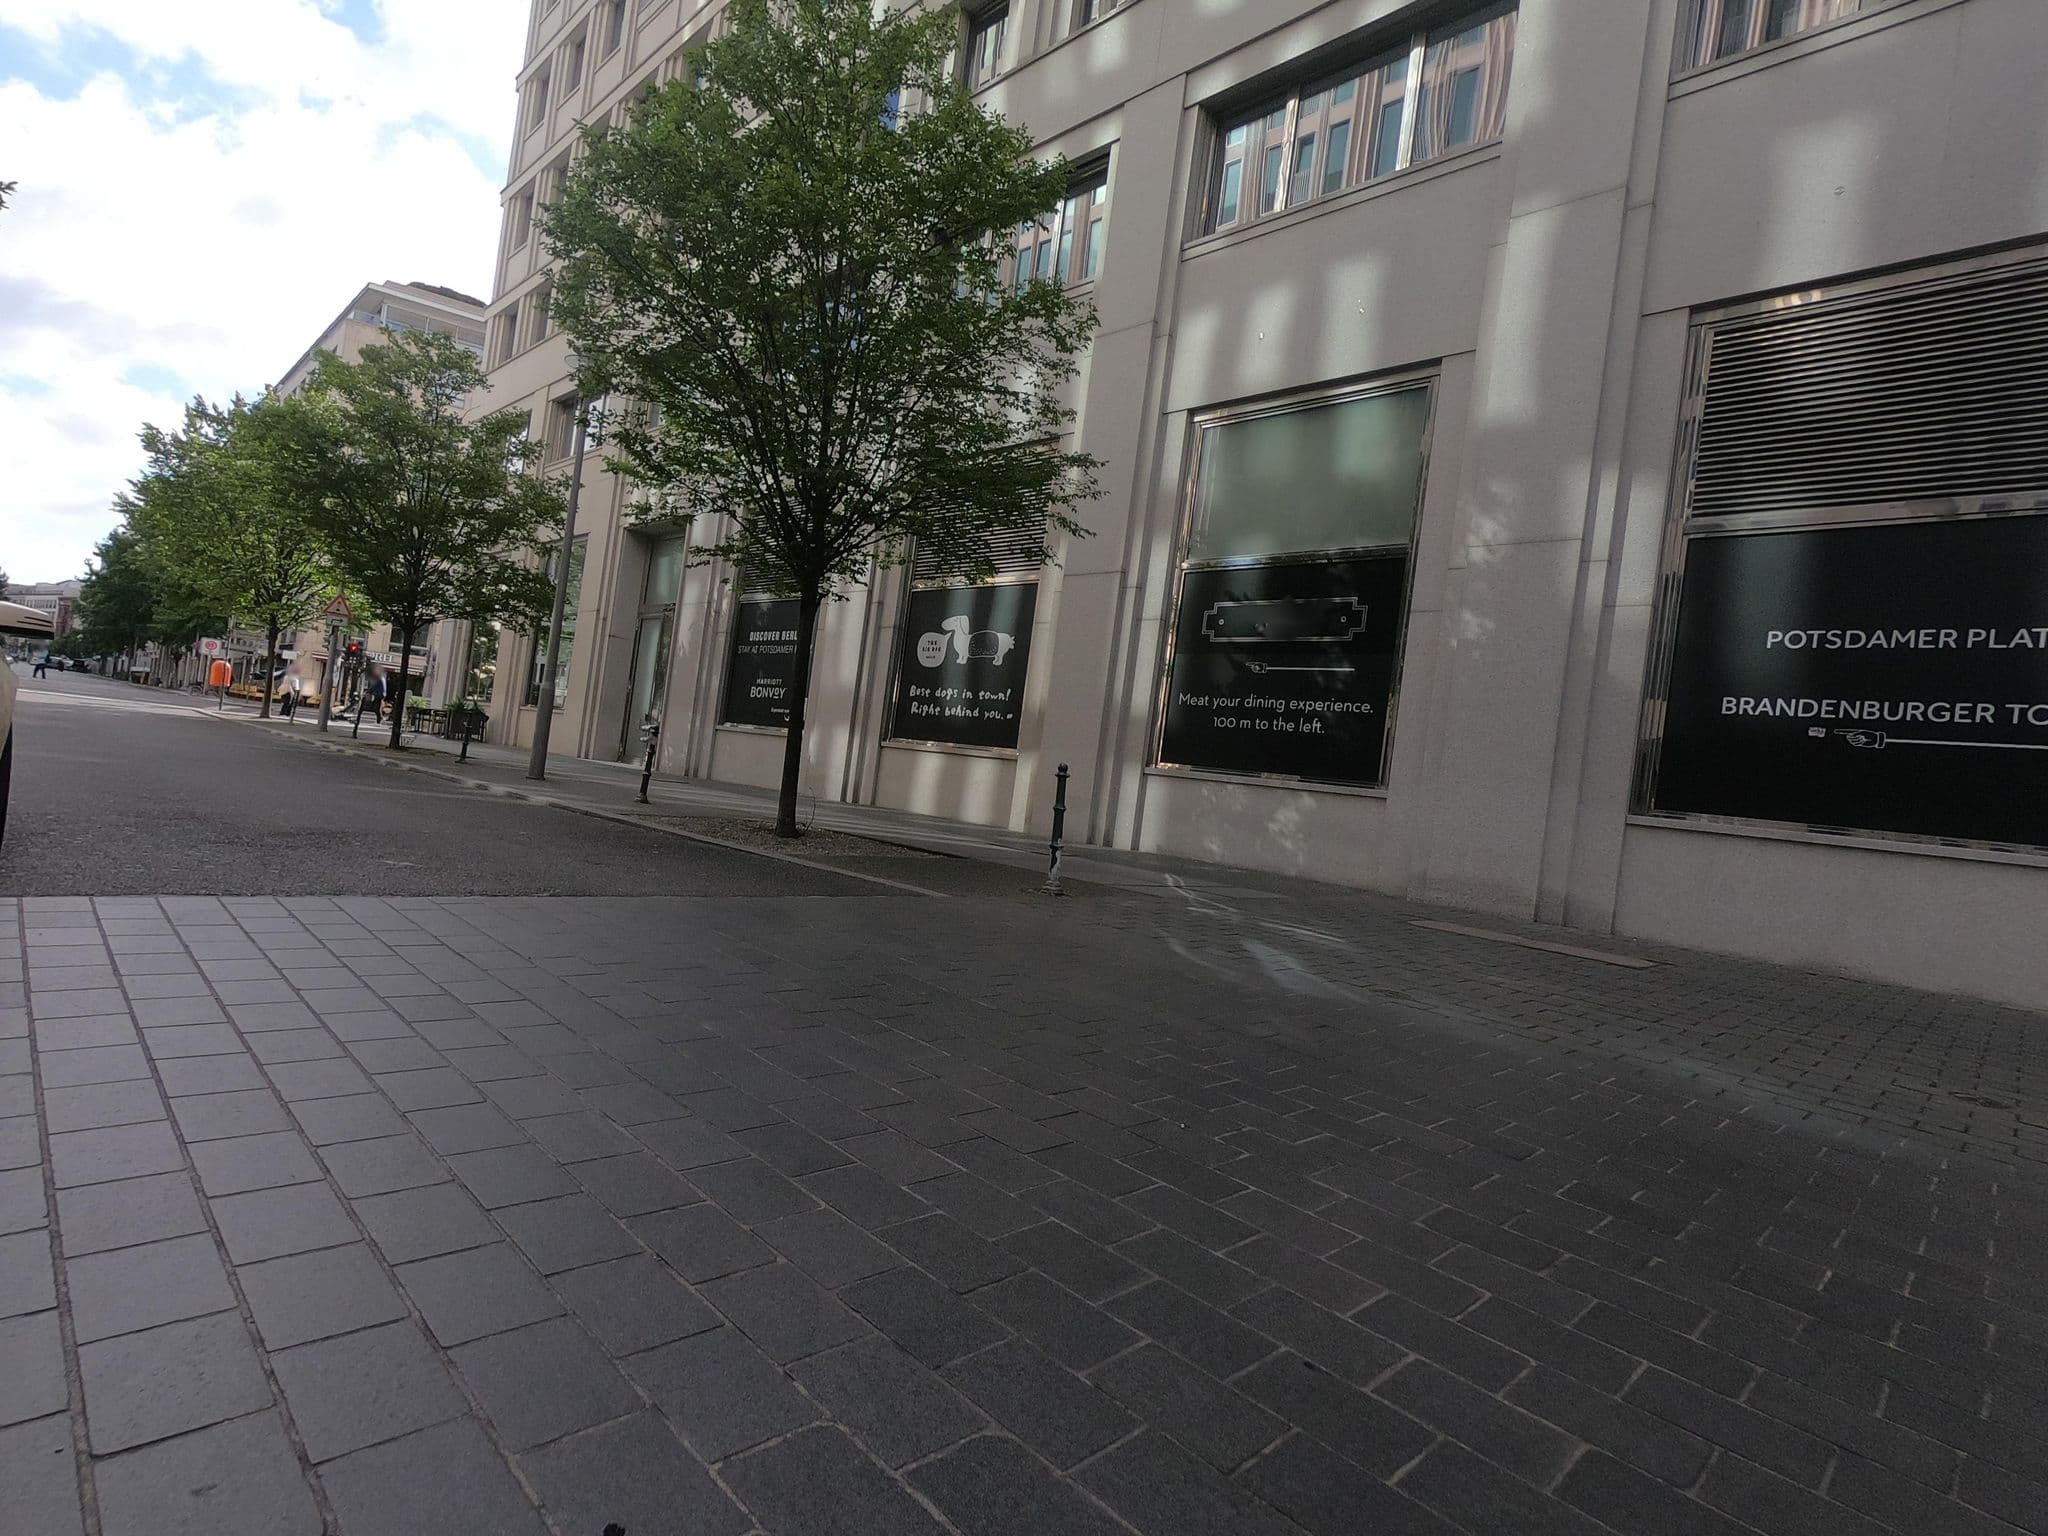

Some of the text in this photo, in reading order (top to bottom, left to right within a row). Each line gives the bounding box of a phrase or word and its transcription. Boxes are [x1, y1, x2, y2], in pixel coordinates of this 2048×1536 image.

[749, 631, 780, 641] DISCOVER
[1766, 629, 1957, 649] POTSDAMER
[738, 645, 750, 654] STAY
[751, 645, 758, 653] AT
[759, 645, 793, 654] POTSDAMER
[750, 686, 787, 699] BONVOY
[935, 687, 958, 700] dogs
[962, 689, 973, 699] in
[978, 688, 1011, 701] town!
[910, 702, 942, 716] Right
[944, 704, 980, 717] behind
[1178, 692, 1374, 714] Meat your dining experience.
[1721, 697, 1995, 724] BRANDENBURGER
[1213, 717, 1325, 734] 100 m to the left.
